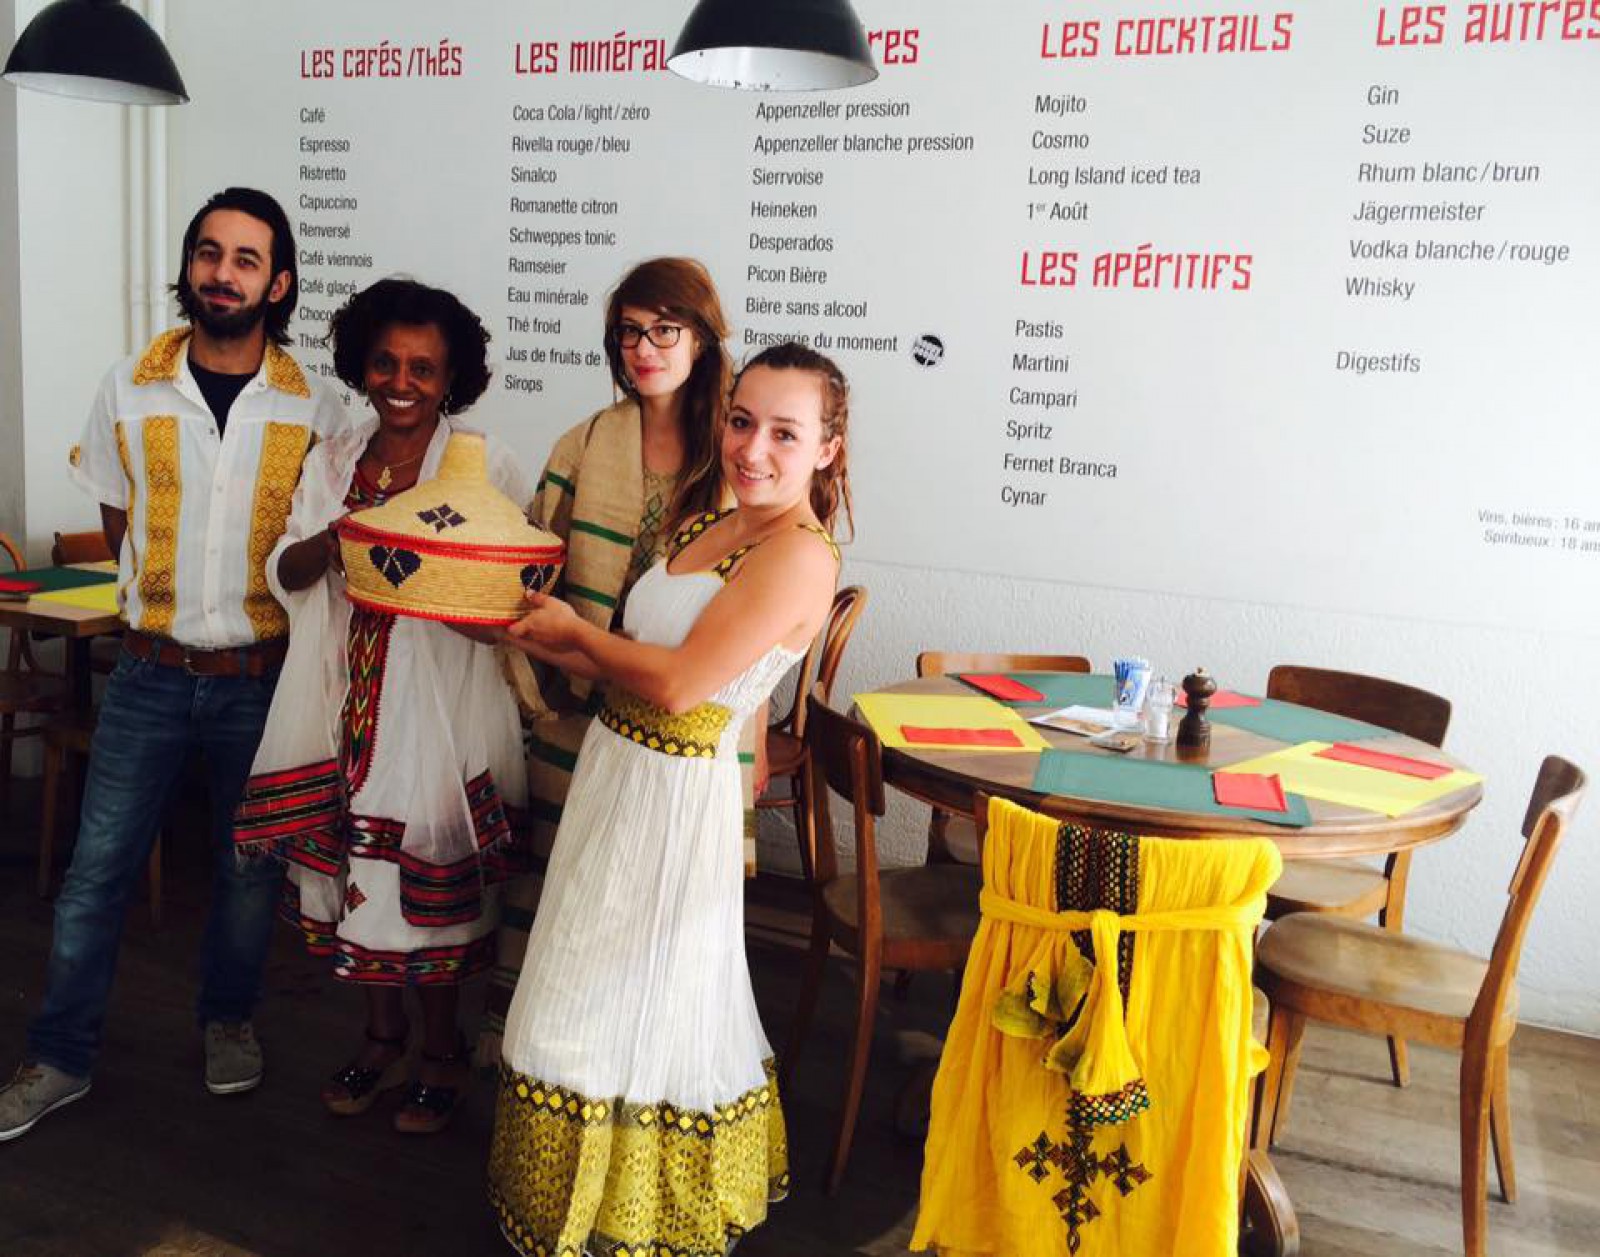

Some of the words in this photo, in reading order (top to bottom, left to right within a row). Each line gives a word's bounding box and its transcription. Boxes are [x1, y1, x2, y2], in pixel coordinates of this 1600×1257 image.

[1367, 84, 1399, 105] Gin
[300, 107, 326, 123] Café
[513, 103, 544, 121] Coca
[756, 101, 840, 122] Appenzeller
[845, 100, 911, 121] pression
[1035, 95, 1087, 117] Mojito
[754, 134, 838, 155] Appenzeller
[842, 134, 903, 153] blanche
[907, 133, 974, 155] pression
[1032, 130, 1089, 149] Cosmo
[1362, 124, 1411, 145] Suze
[300, 138, 350, 155] Espresso
[512, 136, 553, 153] Rivella
[300, 165, 346, 181] Ristretto
[511, 166, 557, 183] Sinalco
[752, 168, 824, 187] Sierrvoise
[1028, 166, 1069, 188] Long
[1074, 166, 1126, 185] Island
[1131, 166, 1167, 185] iced
[1173, 167, 1201, 185] tea
[1358, 162, 1415, 183] Rhum
[300, 194, 357, 213] Capuccino
[510, 198, 577, 215] Romanette
[581, 199, 618, 215] citron
[751, 201, 818, 219] Heineken
[1049, 201, 1089, 220] Août
[1353, 200, 1486, 226] Jägermeister
[300, 222, 350, 239] Renversé
[509, 229, 581, 247] Schweppes
[585, 230, 616, 246] tonic
[749, 233, 834, 254] Desperados
[1350, 239, 1408, 260] Vodka
[300, 250, 324, 267] Café
[327, 252, 373, 269] viennois
[508, 258, 567, 275] Ramseier
[747, 266, 786, 284] Picon
[790, 266, 828, 285] Bière
[300, 278, 324, 294] Café
[1346, 277, 1416, 301] Whisky
[507, 287, 530, 303] Eau
[534, 288, 589, 306] minérale
[300, 306, 336, 321] Choco
[746, 296, 782, 315] Bière
[786, 300, 819, 316] sans
[824, 301, 867, 318] alcool
[507, 316, 529, 333] Thé
[532, 318, 561, 334] froid
[1015, 319, 1064, 339] Pastis
[744, 328, 810, 346] Brasserie
[814, 331, 832, 348] du
[837, 334, 898, 352] moment
[506, 347, 527, 361] Jus
[531, 347, 546, 363] de
[550, 347, 581, 366] fruits
[585, 350, 601, 366] de
[1012, 353, 1069, 373] Martini
[1336, 350, 1421, 374] Digestifs
[504, 374, 543, 393] Sirops
[1009, 387, 1077, 410] Campari
[1006, 420, 1053, 440] Spritz
[1003, 453, 1054, 474] Fernet
[1059, 456, 1118, 478] Branca
[1001, 486, 1047, 507] Cynar
